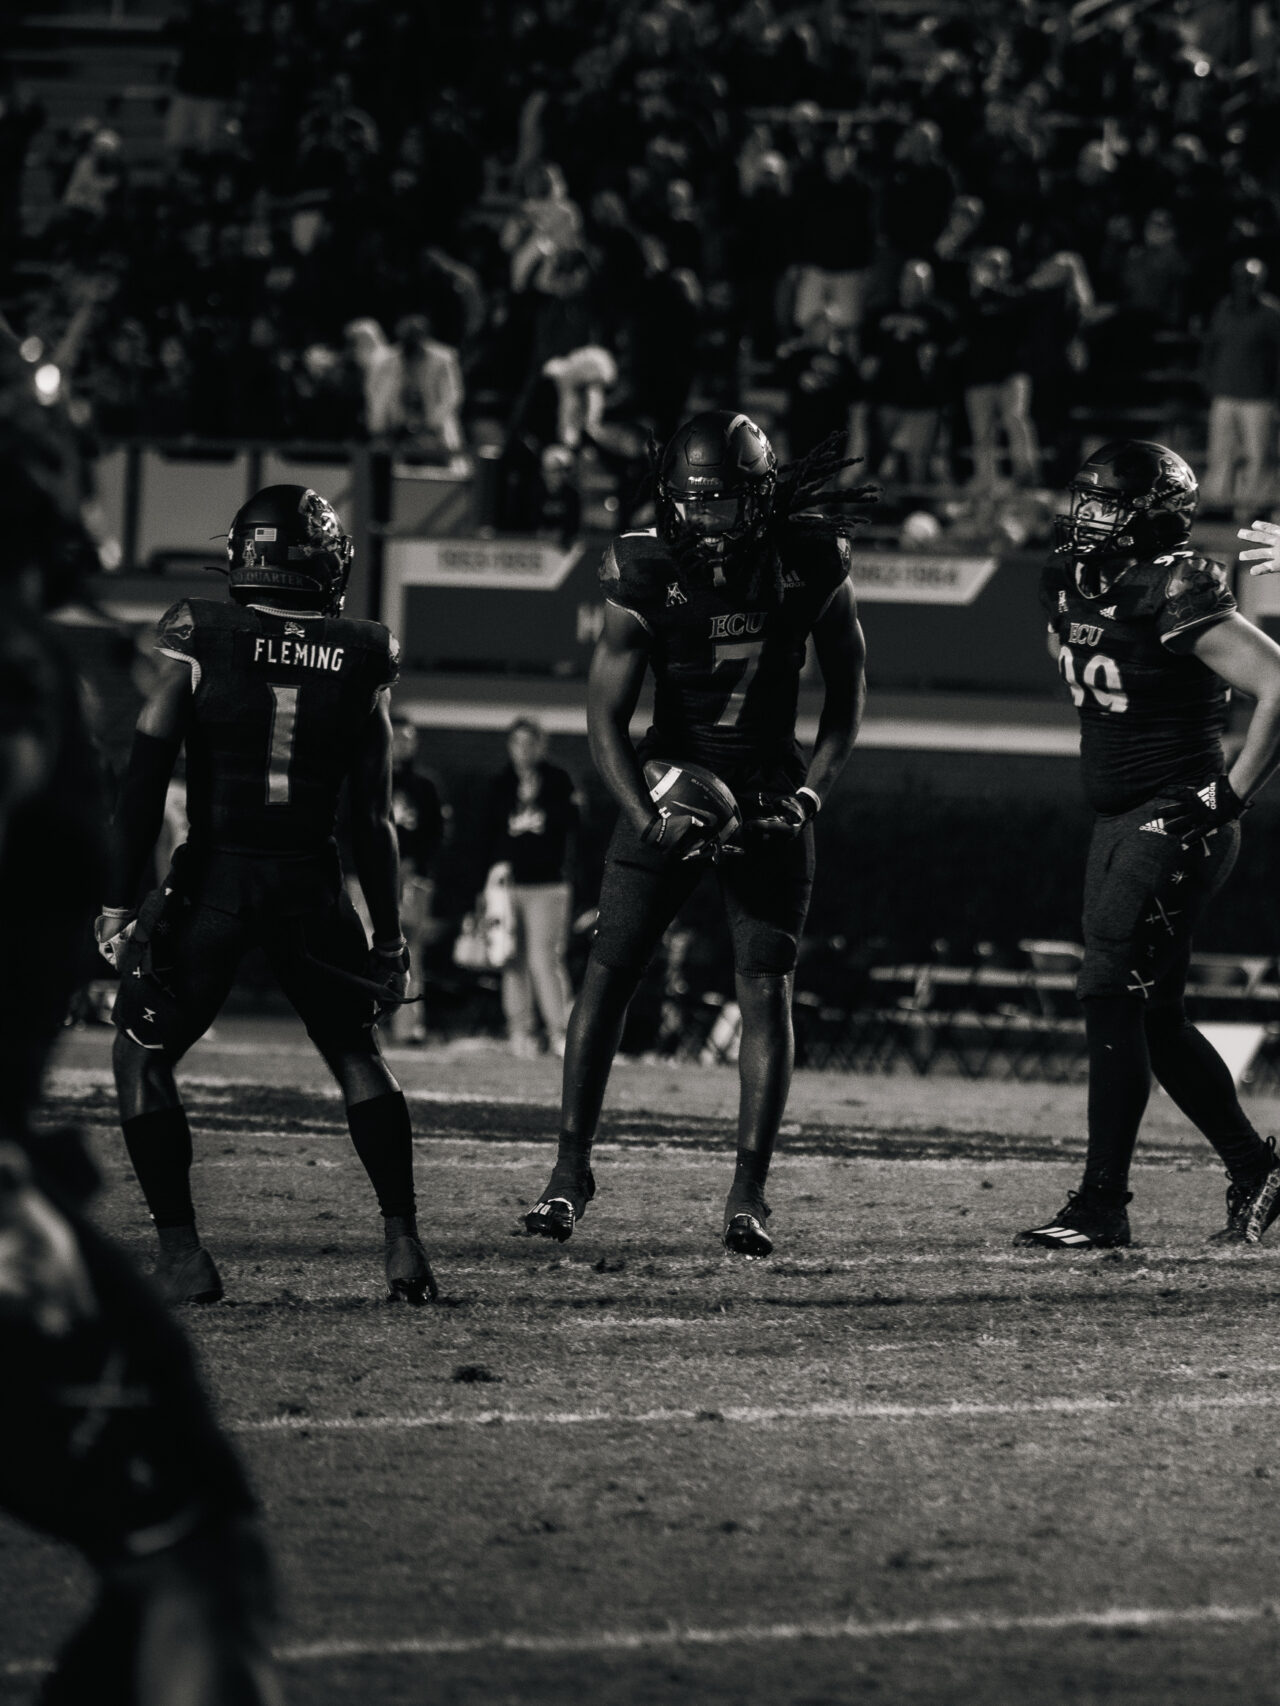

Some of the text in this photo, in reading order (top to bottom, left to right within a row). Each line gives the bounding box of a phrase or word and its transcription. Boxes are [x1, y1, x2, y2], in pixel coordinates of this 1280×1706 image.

[708, 612, 768, 639] ECU
[1068, 622, 1104, 646] ECU
[253, 637, 345, 673] FLEMING
[711, 639, 768, 728] 7
[264, 681, 301, 806] 1
